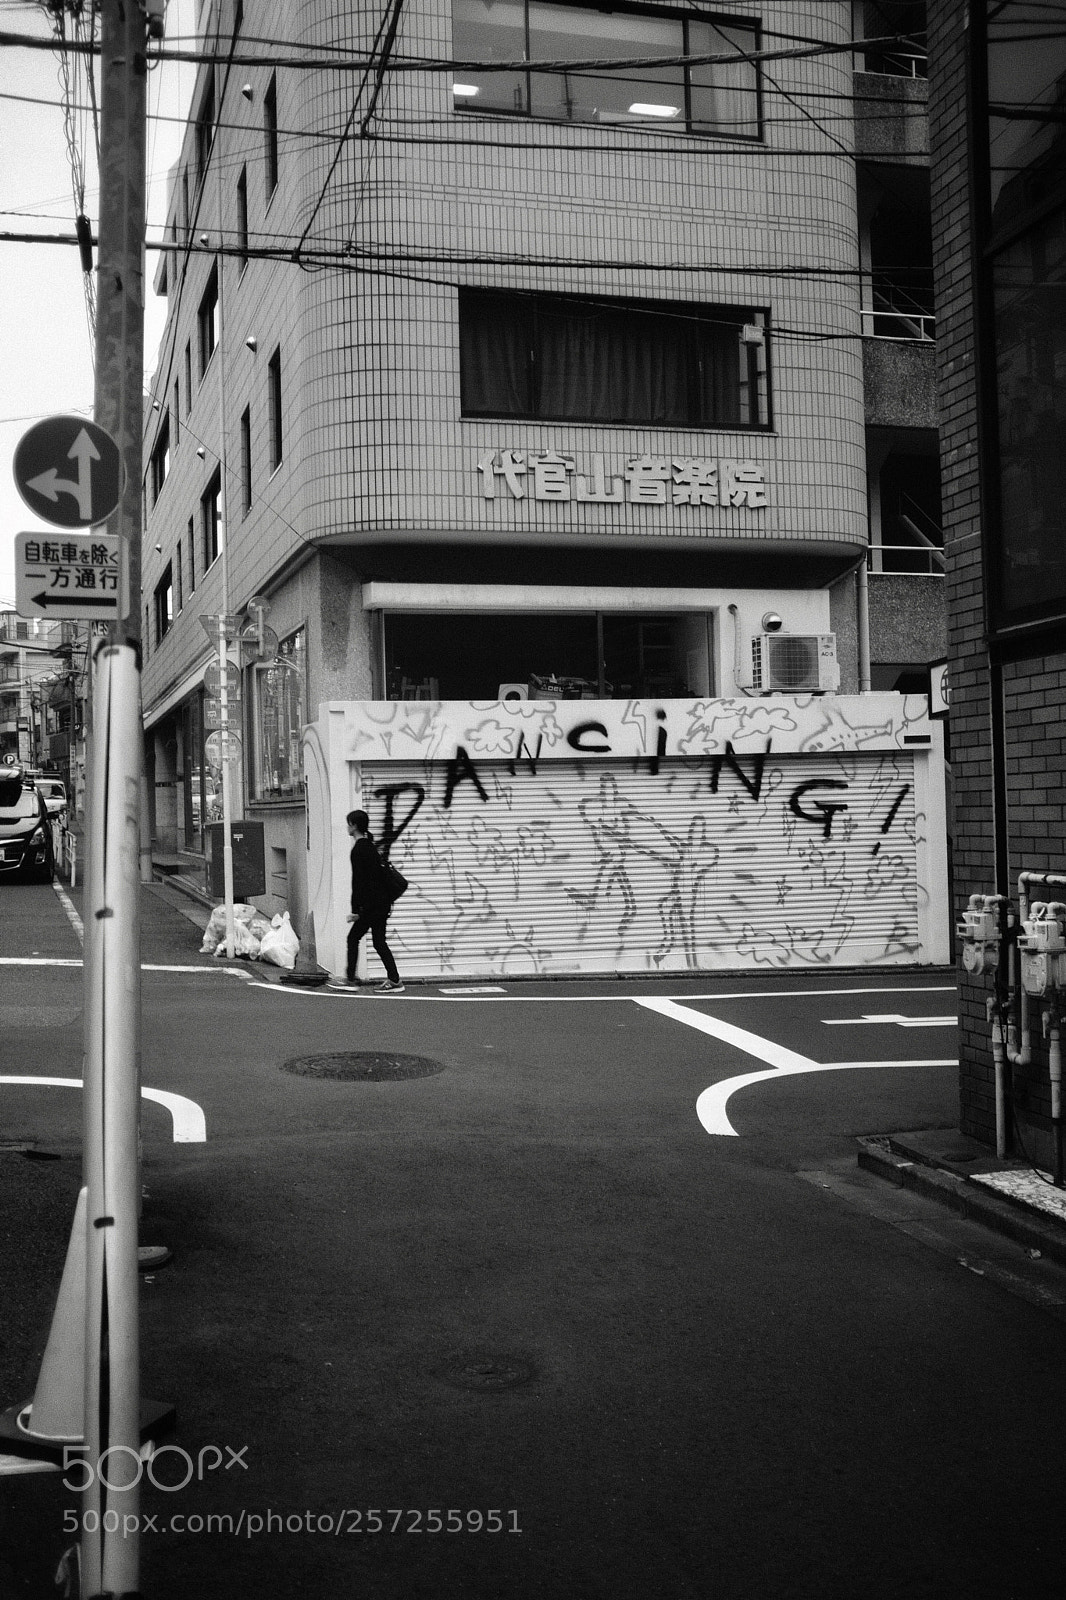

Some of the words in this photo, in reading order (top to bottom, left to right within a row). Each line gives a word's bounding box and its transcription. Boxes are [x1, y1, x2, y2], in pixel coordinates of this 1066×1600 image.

[477, 449, 768, 509] 代官山音楽院
[24, 540, 119, 565] 自転車を除く
[24, 566, 119, 590] 一方通行
